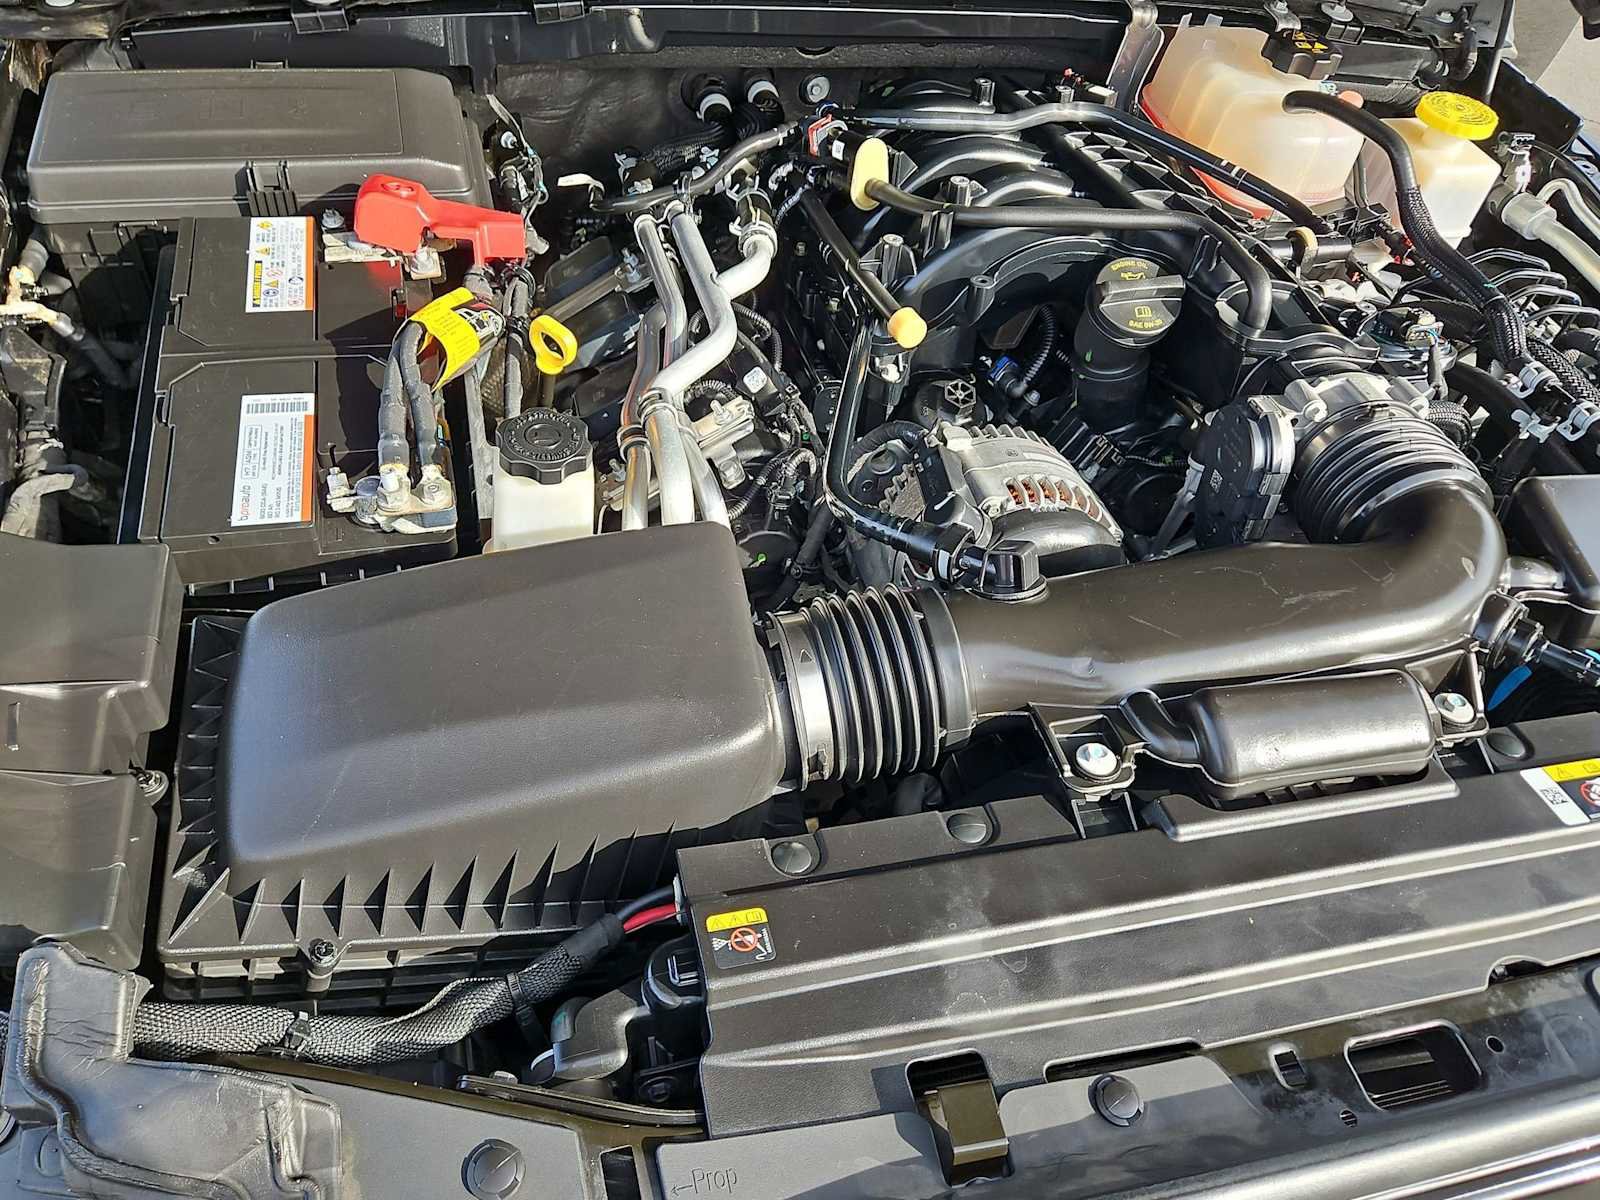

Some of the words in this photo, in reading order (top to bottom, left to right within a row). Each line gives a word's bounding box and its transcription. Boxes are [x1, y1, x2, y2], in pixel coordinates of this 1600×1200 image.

[1111, 260, 1136, 270] ENGINE
[1136, 261, 1149, 270] OIL
[1128, 319, 1143, 329] SAE
[691, 1168, 737, 1194] Prop
